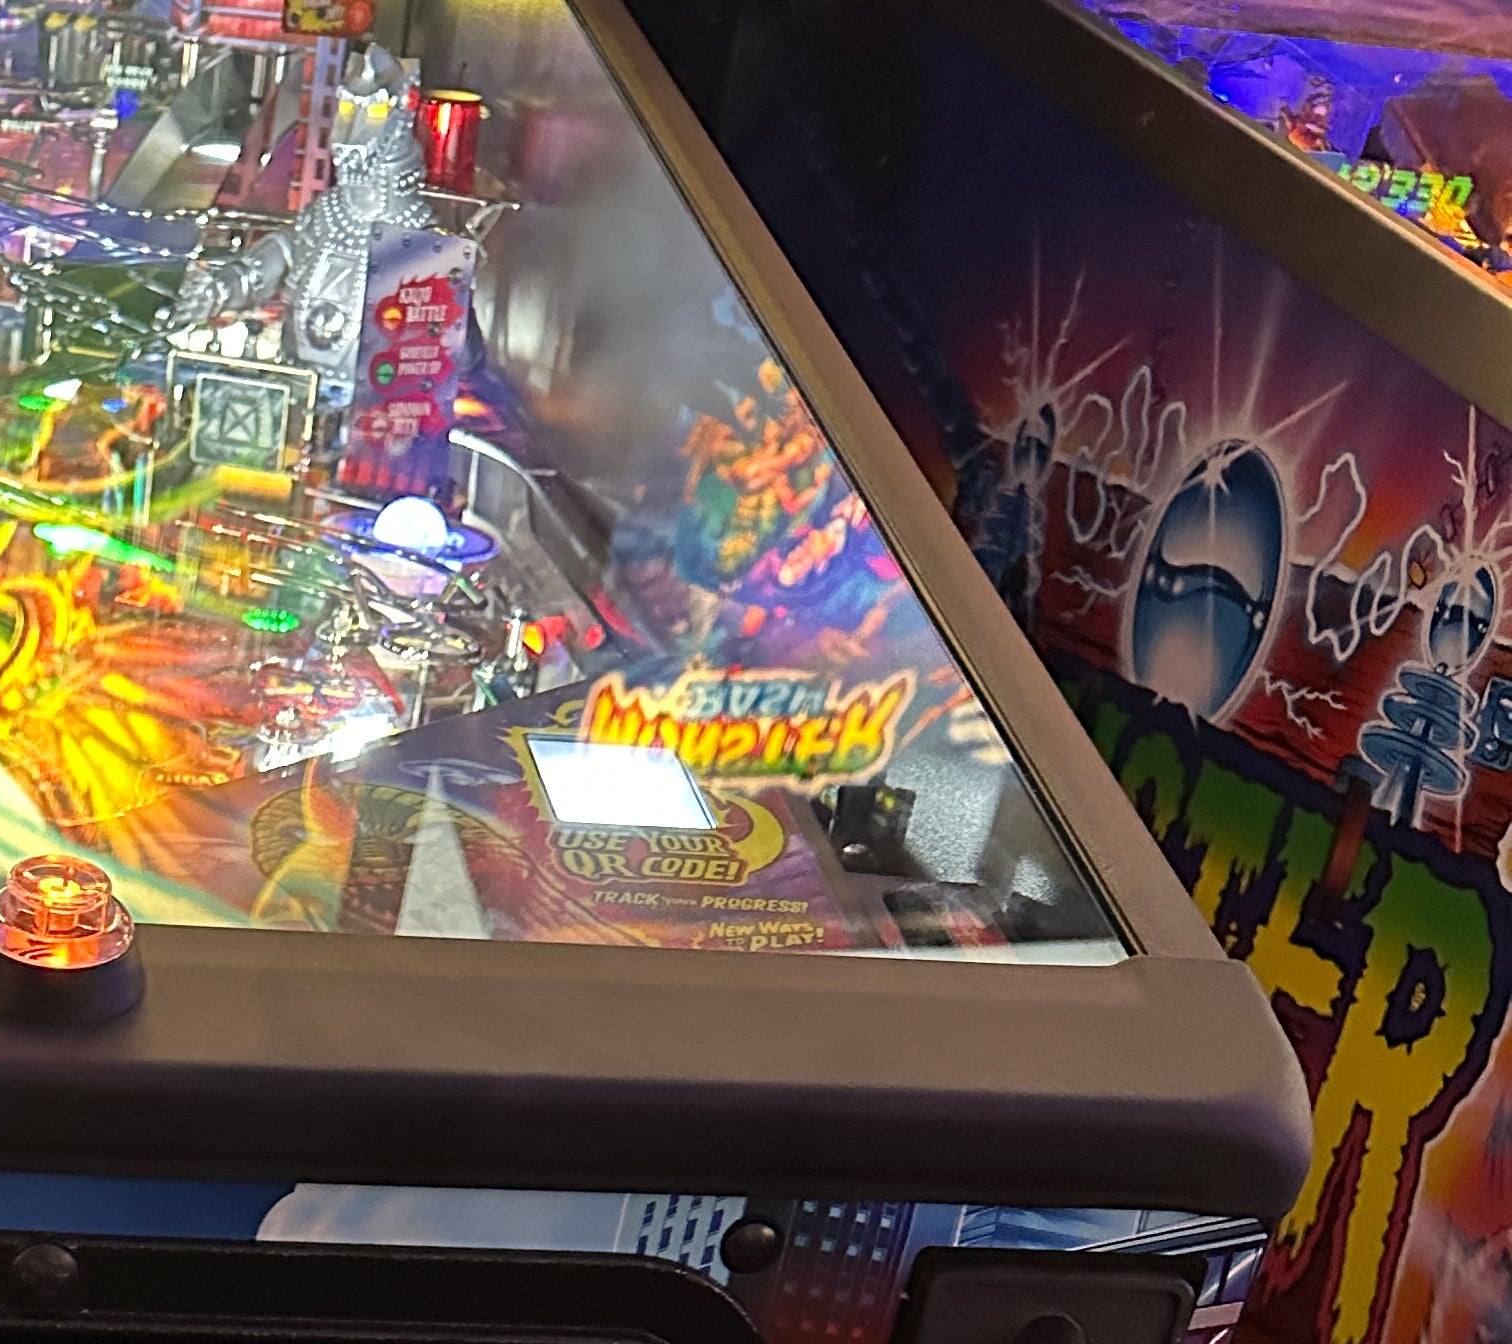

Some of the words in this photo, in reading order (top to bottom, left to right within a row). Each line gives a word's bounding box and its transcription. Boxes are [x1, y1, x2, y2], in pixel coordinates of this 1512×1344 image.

[557, 830, 629, 851] USE
[640, 830, 728, 853] YOUR
[562, 850, 638, 880] QR
[641, 856, 743, 881] CODE!
[592, 890, 661, 906] TRACK
[700, 895, 809, 914] PROGRESS!
